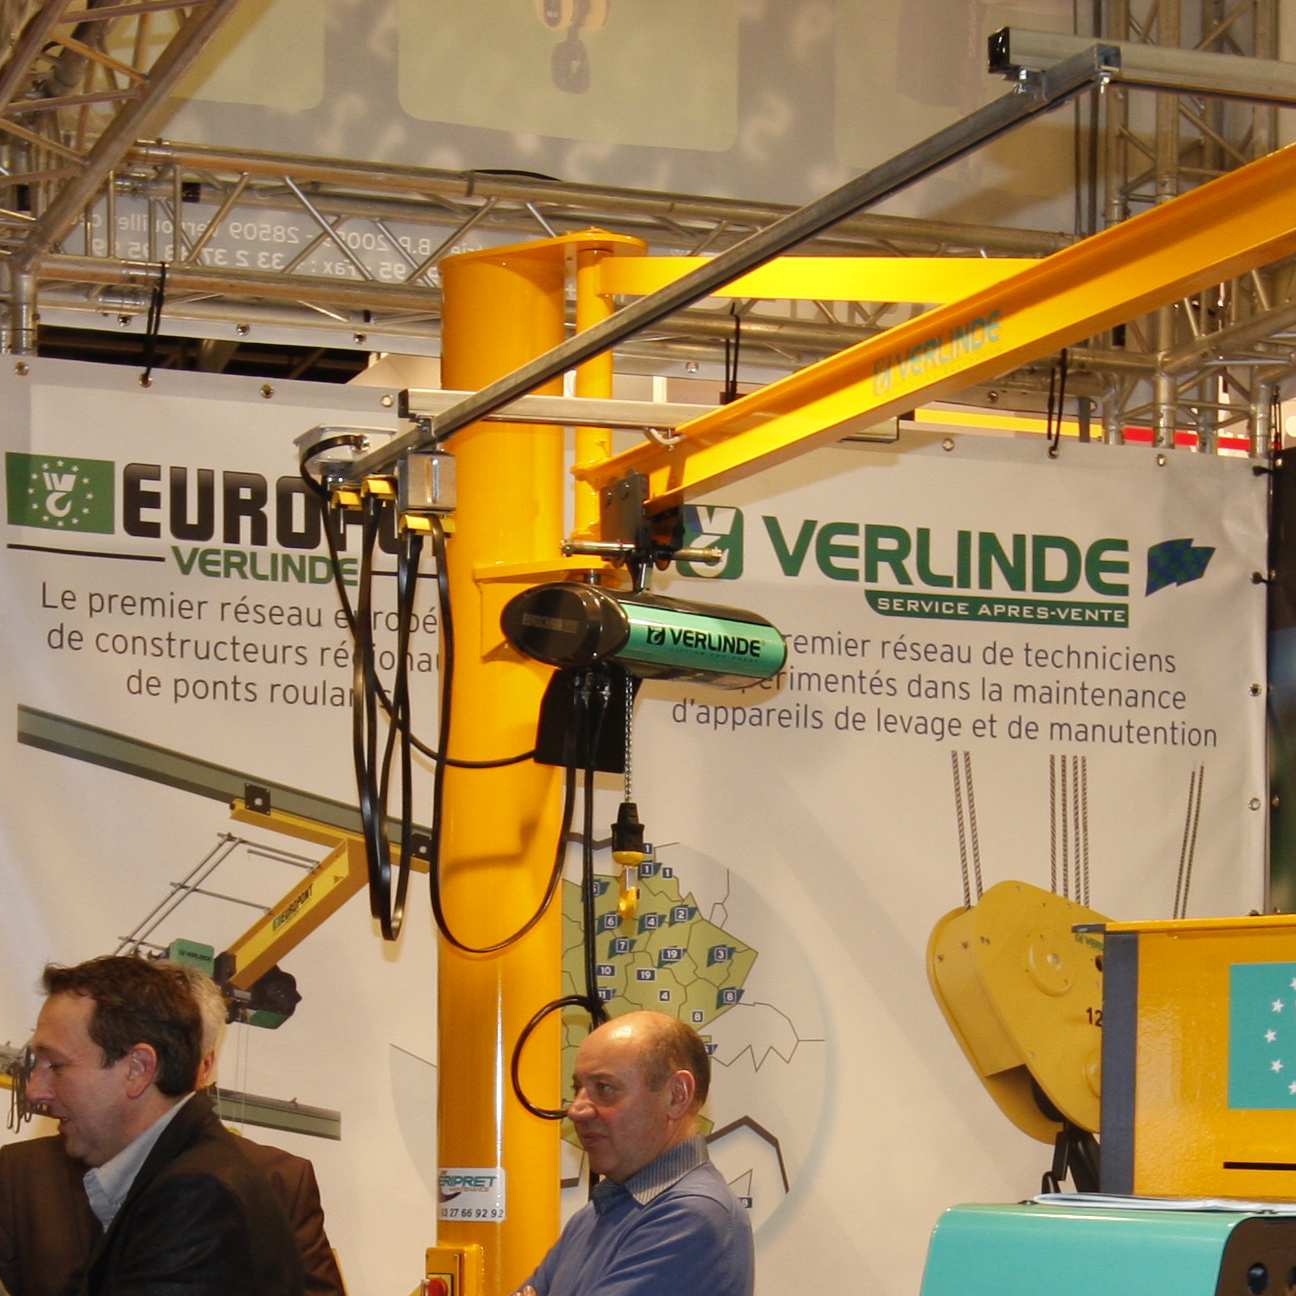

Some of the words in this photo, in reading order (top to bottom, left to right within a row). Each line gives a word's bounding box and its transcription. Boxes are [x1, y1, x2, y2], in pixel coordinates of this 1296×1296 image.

[897, 310, 1002, 379] VERLINDE
[171, 545, 358, 587] VERLINDE
[761, 514, 1130, 597] VERLINDE
[41, 581, 78, 611] Le
[88, 590, 208, 621] premier
[219, 595, 323, 628] réseau
[877, 597, 969, 616] SERVICE
[978, 602, 1128, 624] APRES-VENTE
[47, 622, 84, 651] de
[95, 630, 308, 667] constructeurs
[671, 628, 761, 658] VERLINDE
[785, 630, 872, 658] remier
[881, 635, 972, 664] réseau
[981, 638, 1014, 667] de
[1023, 643, 1177, 674] techniciens
[126, 668, 162, 697] de
[173, 674, 258, 704] ponts
[906, 673, 971, 701] dans
[981, 674, 1003, 703] la
[1013, 678, 1187, 711] maintenance
[672, 700, 824, 731] d'appareils
[834, 705, 866, 732] de
[876, 709, 963, 743] levage
[972, 714, 997, 739] et
[1007, 712, 1040, 742] de
[1049, 716, 1218, 748] manutention
[475, 1208, 488, 1218] 92
[490, 1208, 504, 1218] 92
